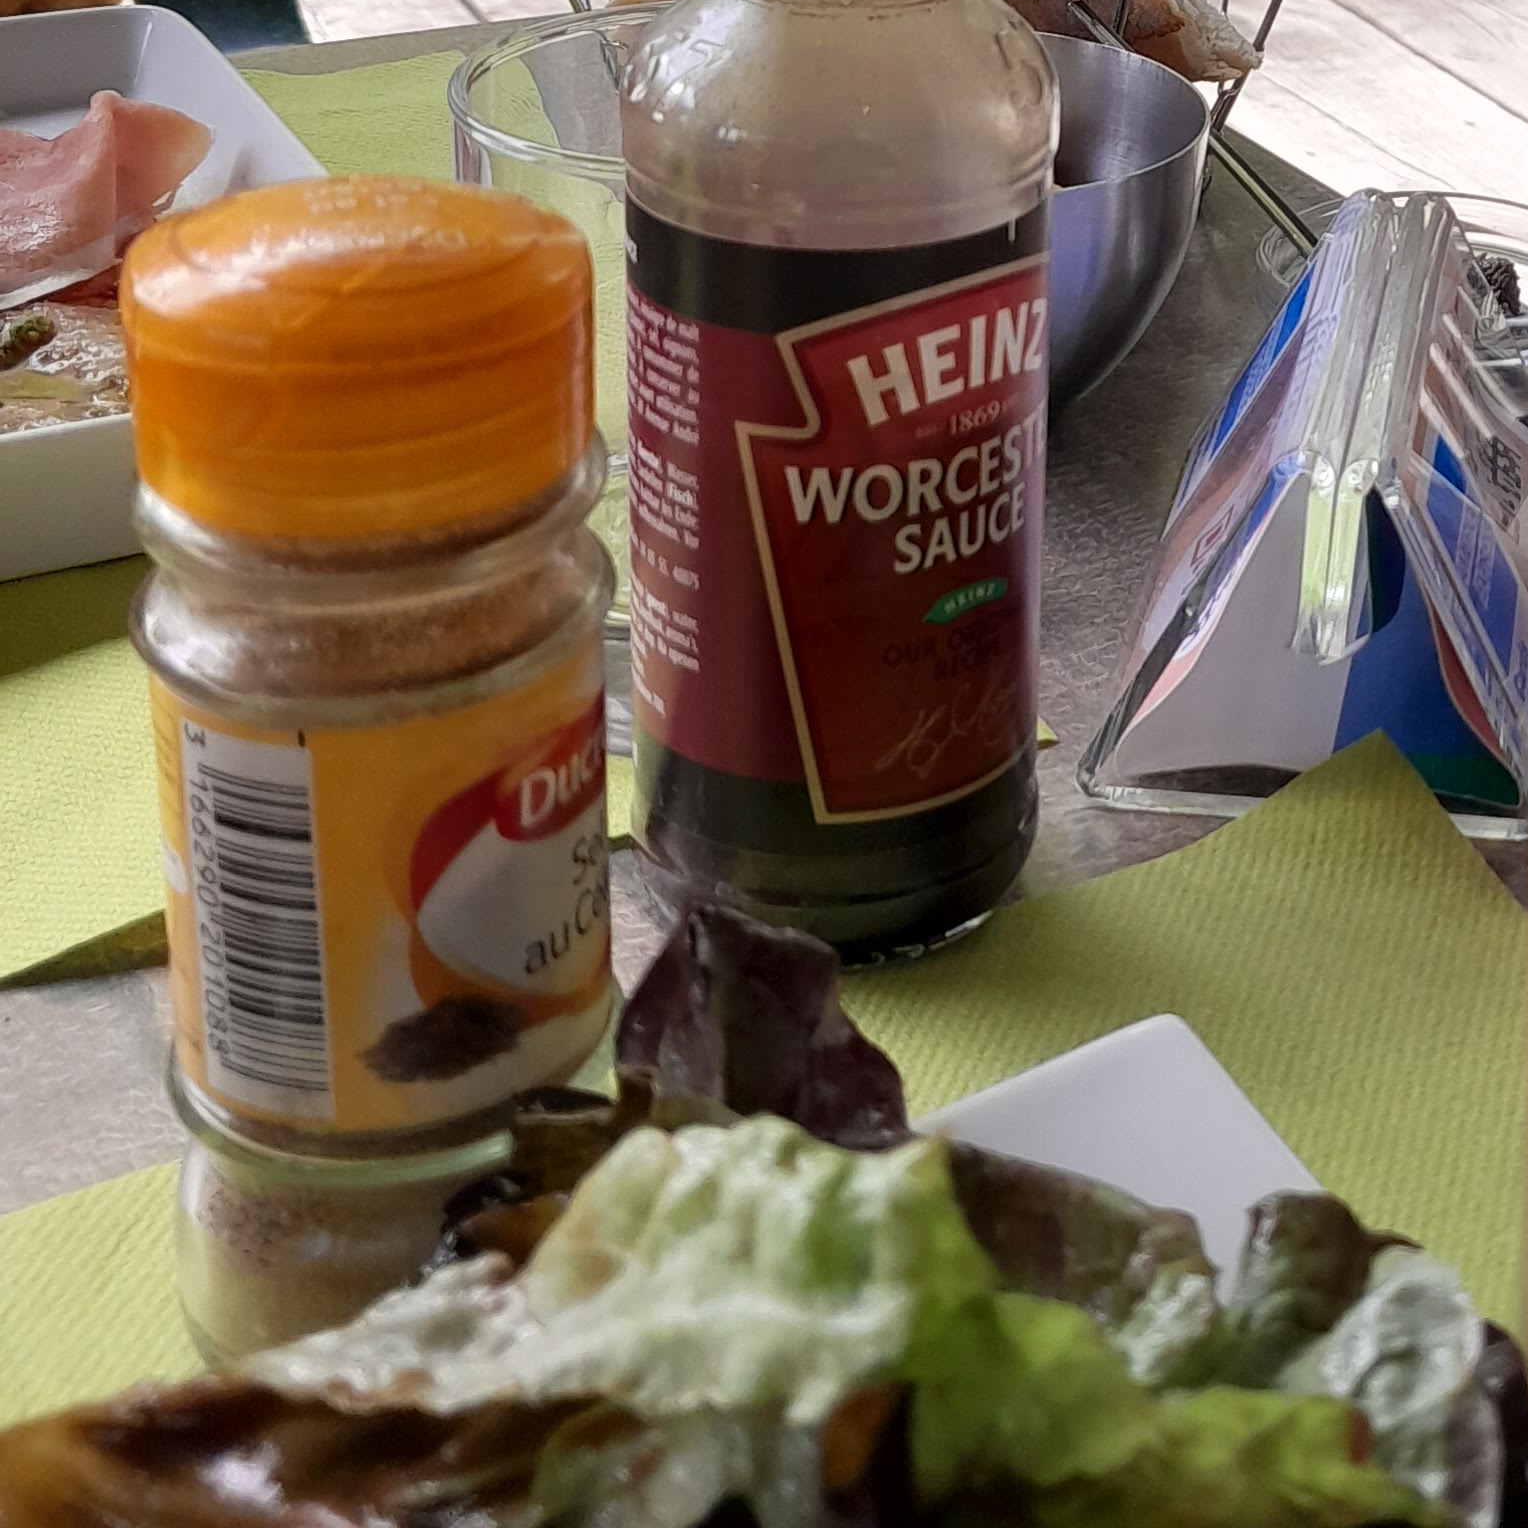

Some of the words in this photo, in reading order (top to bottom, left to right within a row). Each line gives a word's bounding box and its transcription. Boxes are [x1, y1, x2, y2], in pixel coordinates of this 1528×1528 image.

[848, 297, 1048, 426] HEINZ
[950, 399, 1002, 436] 1869
[894, 481, 1026, 575] SAUCE
[183, 722, 207, 747] 3
[521, 734, 604, 828] Duc
[525, 921, 570, 974] au
